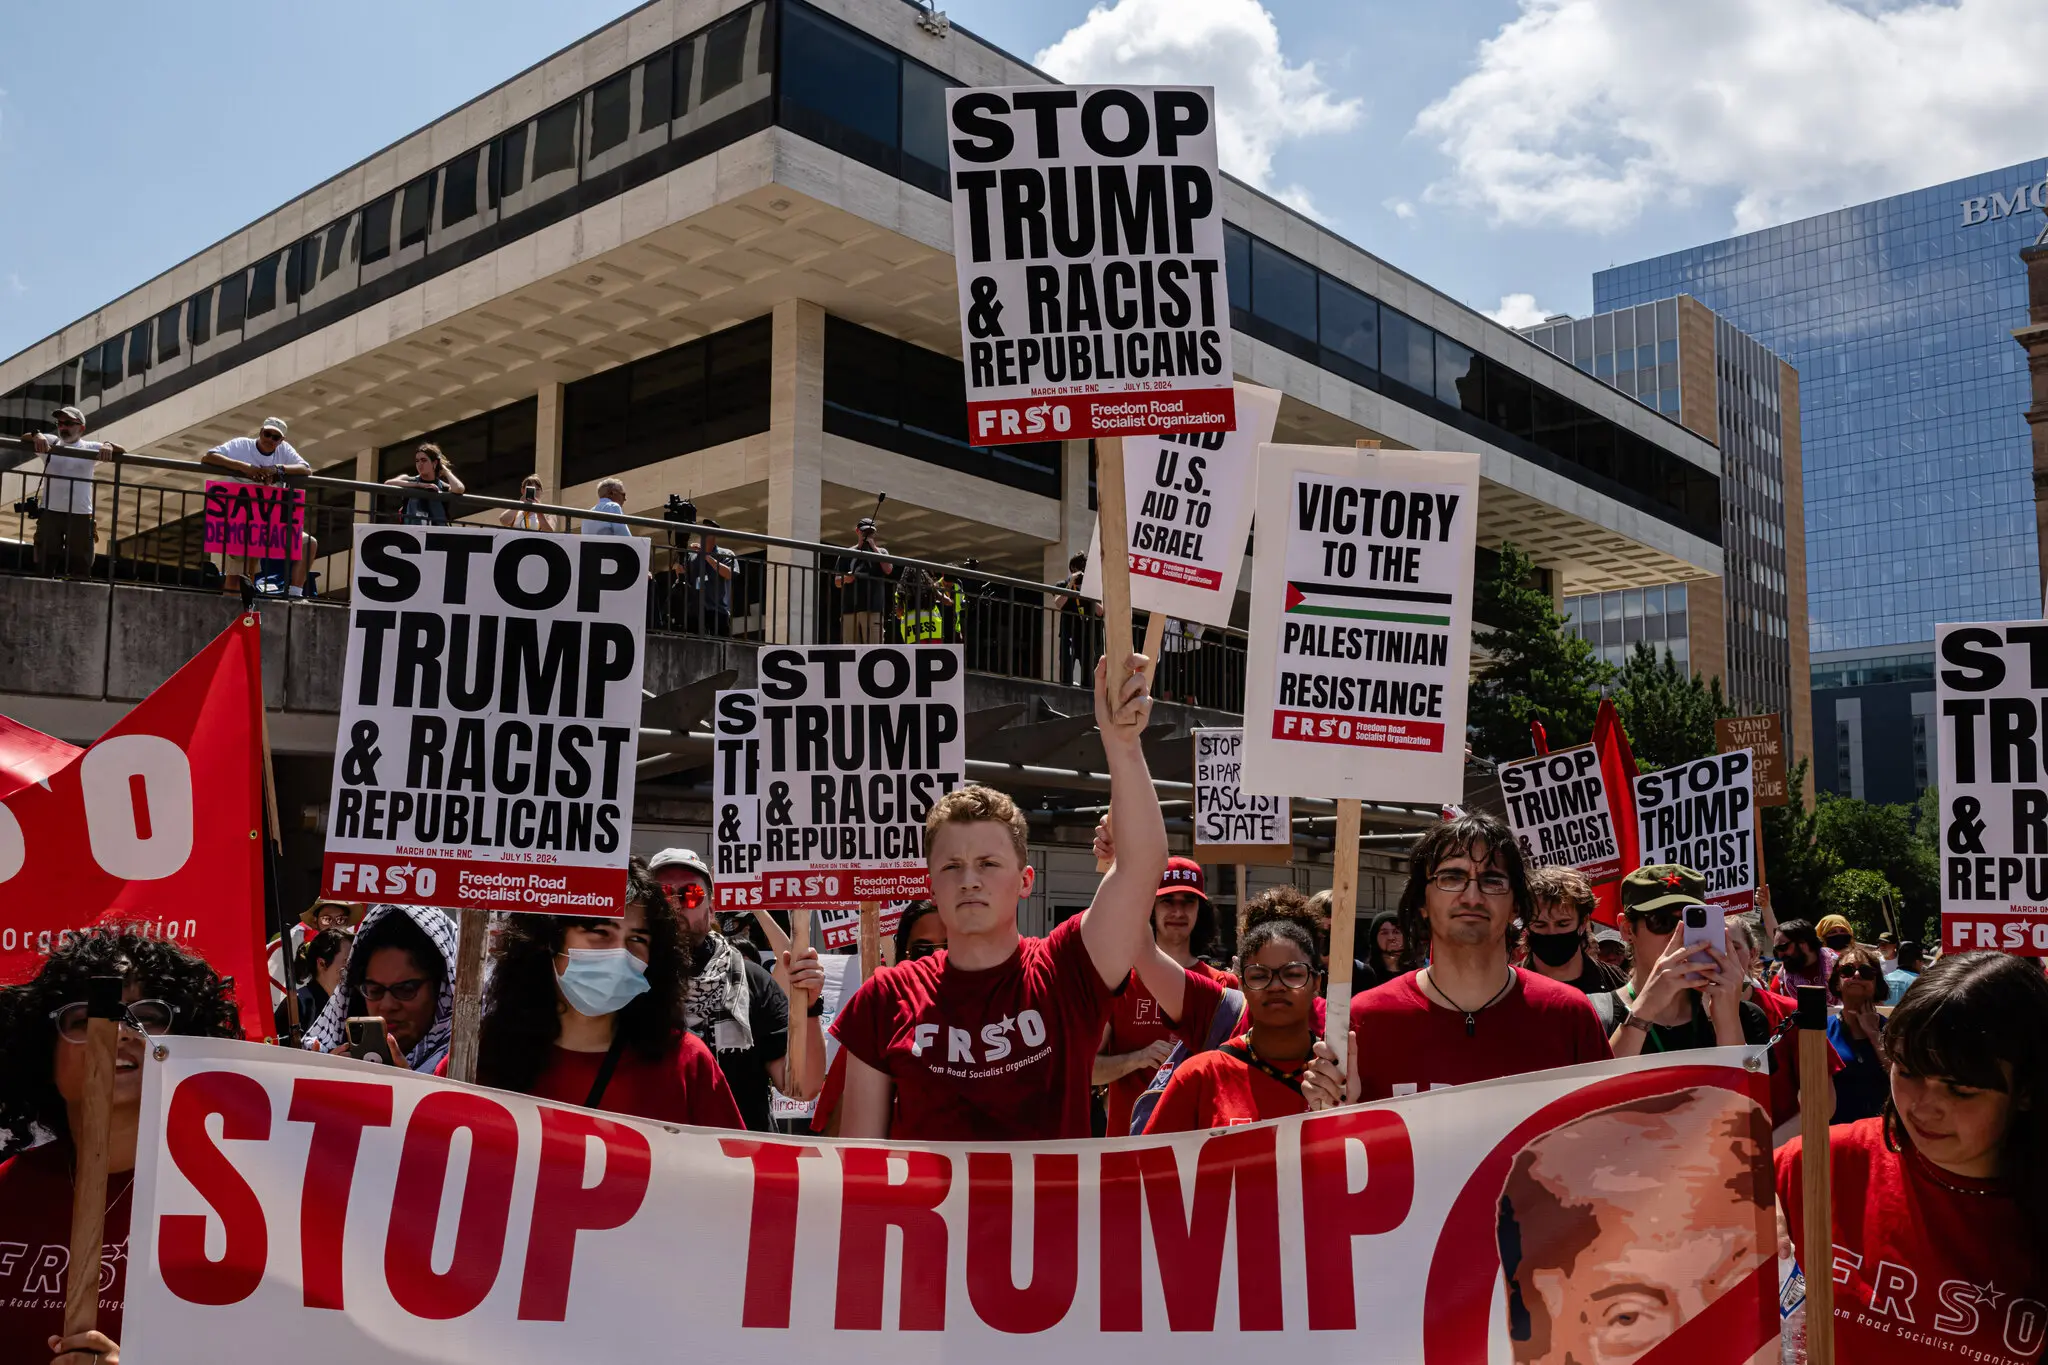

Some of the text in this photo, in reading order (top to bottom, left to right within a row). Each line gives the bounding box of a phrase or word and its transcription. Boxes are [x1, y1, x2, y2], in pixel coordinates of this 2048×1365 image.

[952, 88, 1209, 163] STOP
[957, 165, 1213, 262] TRUMP
[967, 259, 1219, 338] & RACIST
[970, 330, 1222, 388] REPUBLICANS
[1031, 387, 1056, 396] MARCH
[1058, 386, 1068, 394] ON
[1070, 385, 1083, 394] THE
[1085, 384, 1099, 393] RNC
[1123, 382, 1140, 391] JULY
[1154, 381, 1172, 390] 2024
[1090, 400, 1183, 416] Freedom Road
[978, 402, 1071, 437] FRSO
[1091, 413, 1225, 430] Socialist Organization
[1155, 449, 1211, 497] U.S.
[206, 485, 302, 524] SAVE
[1141, 490, 1212, 529] AID TO
[1298, 482, 1460, 542] VICTORY
[204, 520, 303, 550] DEMOCRACY
[1132, 521, 1203, 561] ISRAEL
[358, 530, 640, 613] STOP
[1322, 540, 1421, 583] TO THE
[1283, 622, 1448, 666] PALESTINIAN
[356, 610, 635, 719] TRUMP
[761, 648, 958, 700] STOP
[718, 693, 759, 735] S
[1279, 672, 1443, 718] RESISTANCE
[763, 703, 958, 772] TRUMP
[1283, 715, 1351, 739] FRSO
[1355, 731, 1430, 746] Socialist Organization
[1356, 722, 1406, 735] Freedom Road
[1727, 718, 1771, 733] STAND
[1733, 731, 1767, 744] WITH
[341, 715, 630, 800] & RACIST
[1201, 736, 1241, 757] STOP
[1725, 741, 1778, 757] PASTINE
[1198, 762, 1242, 783] BIPAR
[1501, 750, 1595, 793] STOP
[1637, 752, 1749, 808] STOP
[765, 781, 793, 827] &
[811, 773, 959, 825] RACIST
[1507, 777, 1602, 829] TRUMP
[1640, 786, 1750, 852] TRUMP
[335, 789, 620, 853] REPUBLICANS
[718, 804, 741, 843] &
[1207, 812, 1275, 841] STATE
[1519, 812, 1610, 857] & RACIST
[1947, 796, 1986, 855] &
[396, 845, 424, 856] MARCH
[426, 848, 437, 857] ON
[440, 848, 454, 858] THE
[456, 850, 472, 859] RNC
[500, 851, 520, 861] JULY
[536, 853, 557, 863] 2024
[332, 861, 437, 898] FRSO
[459, 871, 567, 890] Freedom Road
[769, 875, 839, 897] FRSO
[854, 875, 925, 886] Freedom Road
[854, 885, 895, 896] Socialist
[1163, 870, 1197, 882] FRSO
[458, 885, 613, 907] Socialist Organization
[2010, 904, 2037, 913] MARCH
[2, 915, 197, 955] Orgaation
[911, 1009, 1047, 1064] FRSO
[947, 1067, 967, 1078] Road
[969, 1066, 1004, 1079] Socialist
[1005, 1046, 1052, 1072] Organization
[158, 1070, 1415, 1333] STOP TRUMP
[1856, 1313, 1890, 1333] Road
[1896, 1327, 1954, 1352] Socialist
